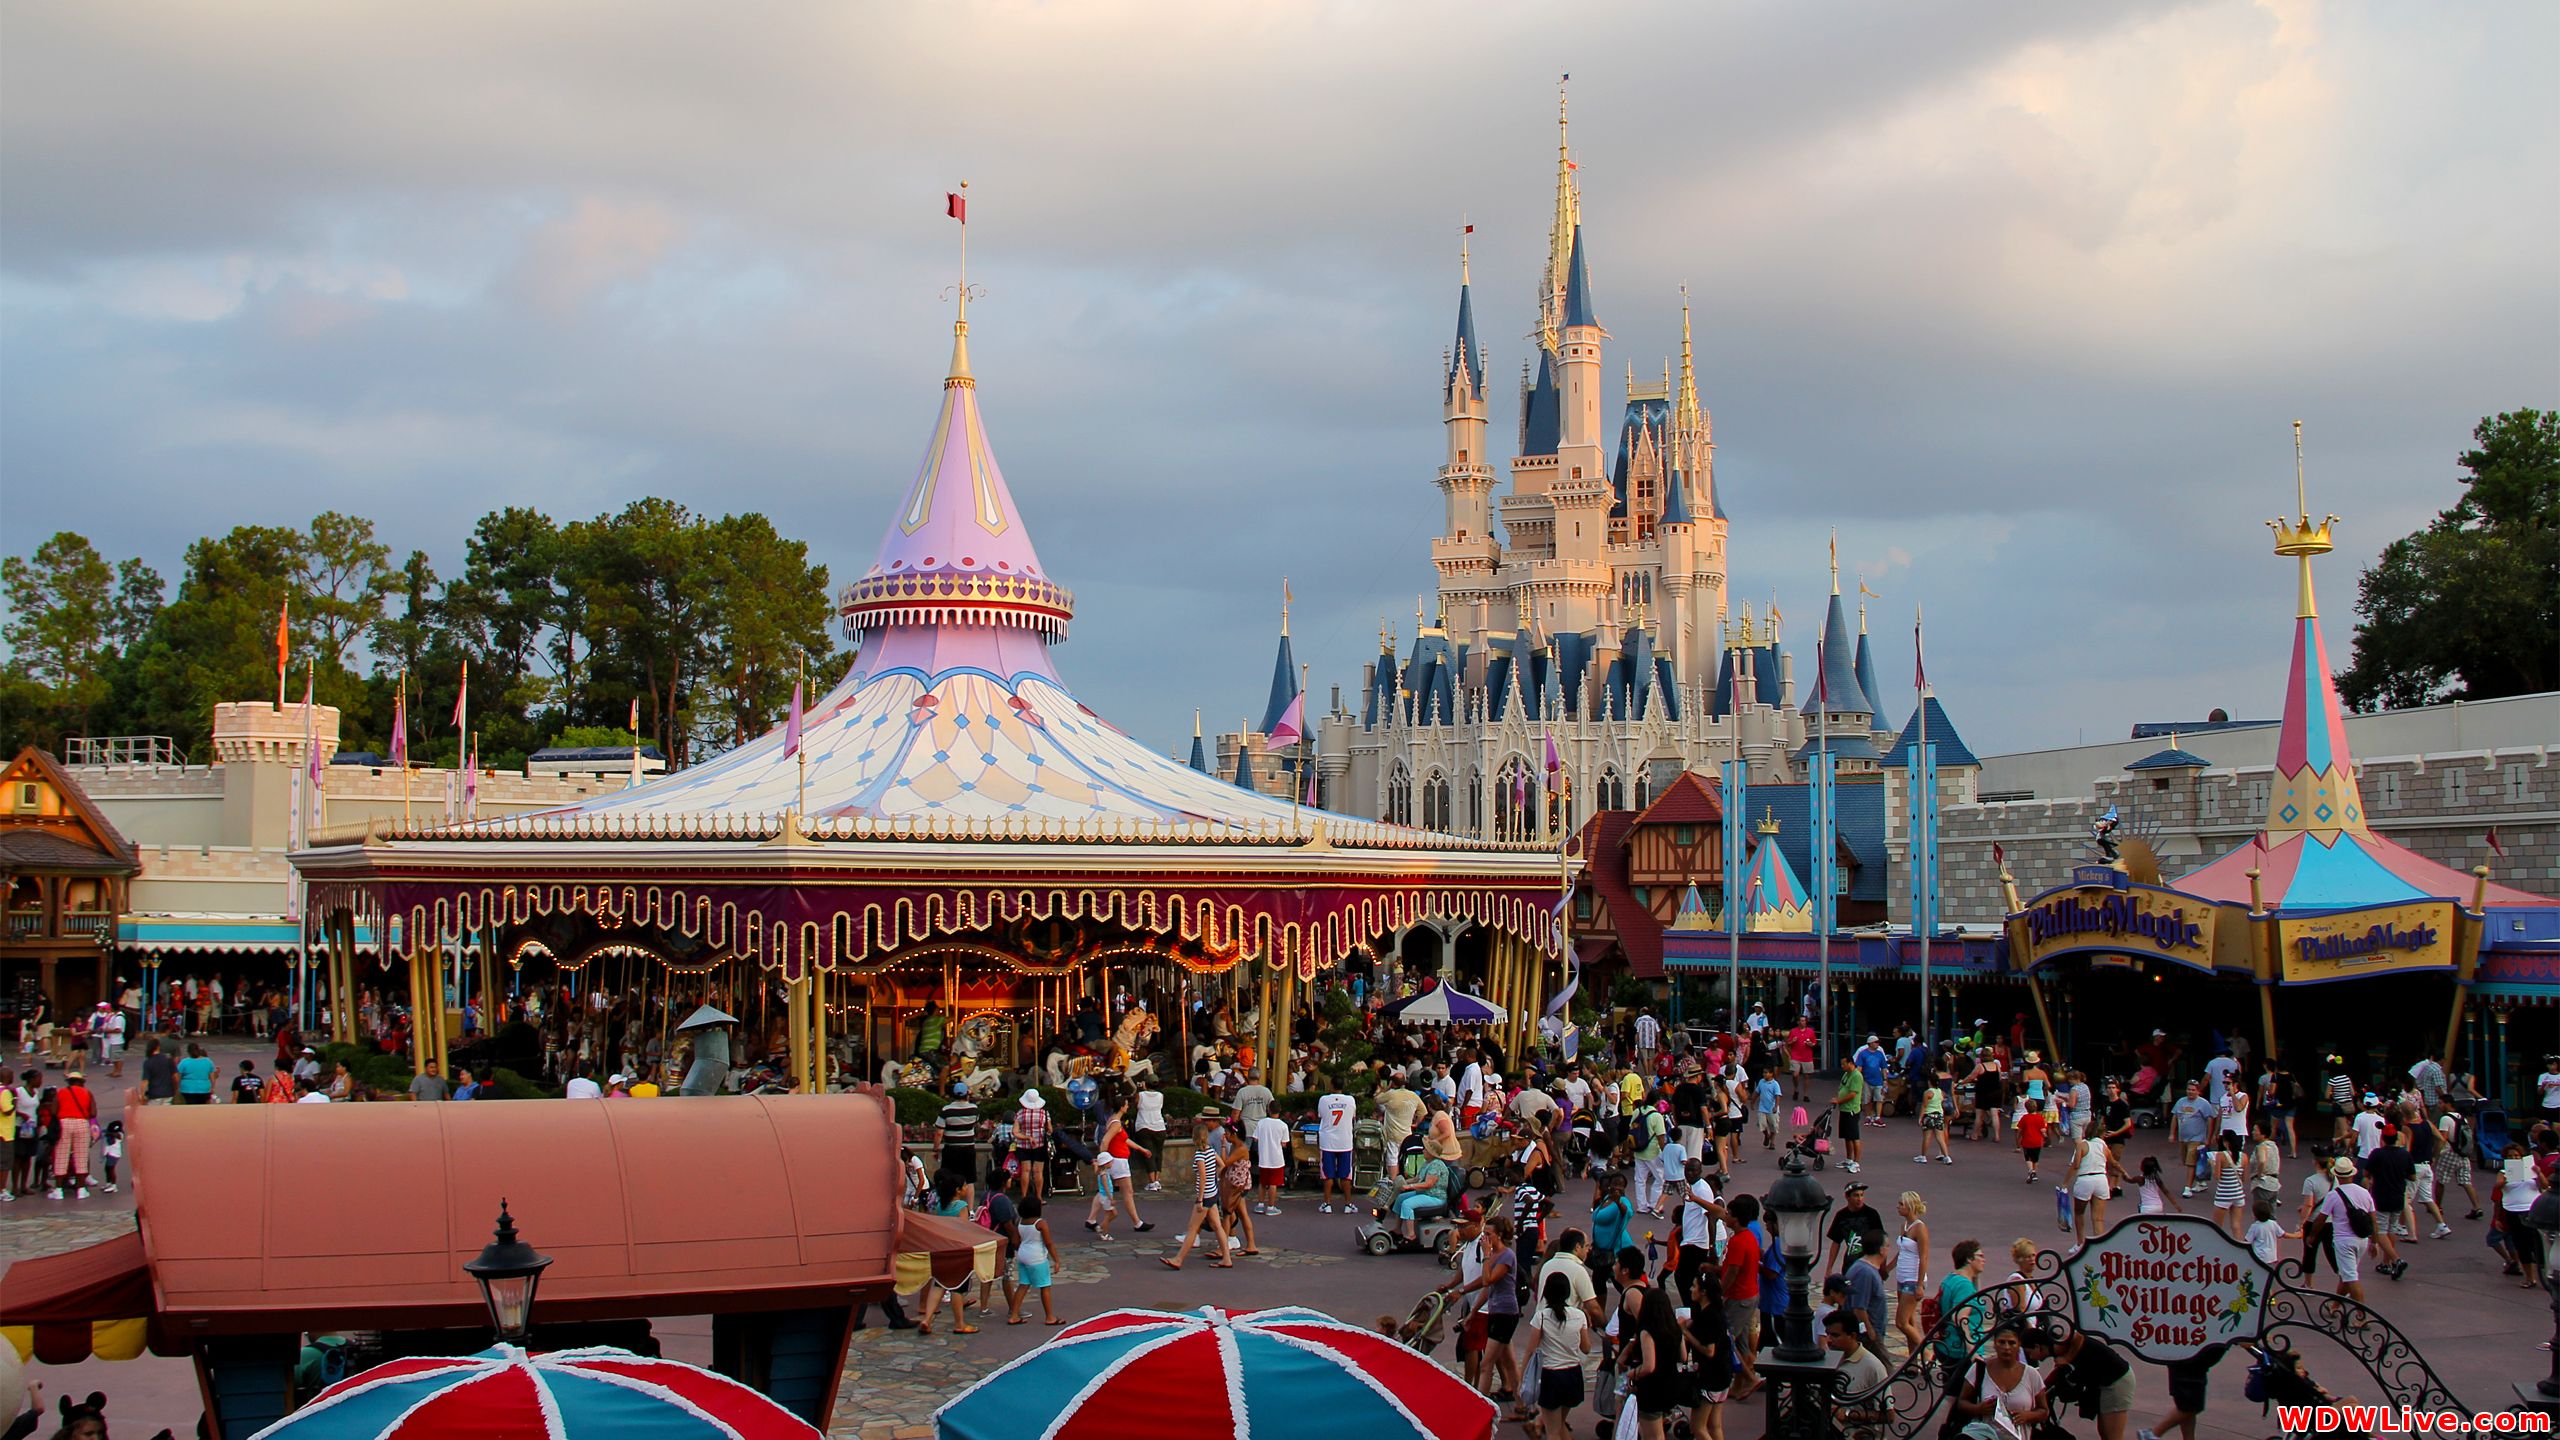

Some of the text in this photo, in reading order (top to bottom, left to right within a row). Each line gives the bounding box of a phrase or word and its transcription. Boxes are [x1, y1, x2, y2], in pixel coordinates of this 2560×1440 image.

[2077, 867, 2111, 884] Mickey's
[2028, 895, 2202, 949] PhilharMagic
[2295, 921, 2438, 962] PhilharMagic
[1331, 1109, 1344, 1126] 7
[2138, 1222, 2193, 1261] The
[2100, 1251, 2239, 1290] Pinocchio
[2115, 1284, 2223, 1325] Village
[2130, 1315, 2207, 1348] Haus
